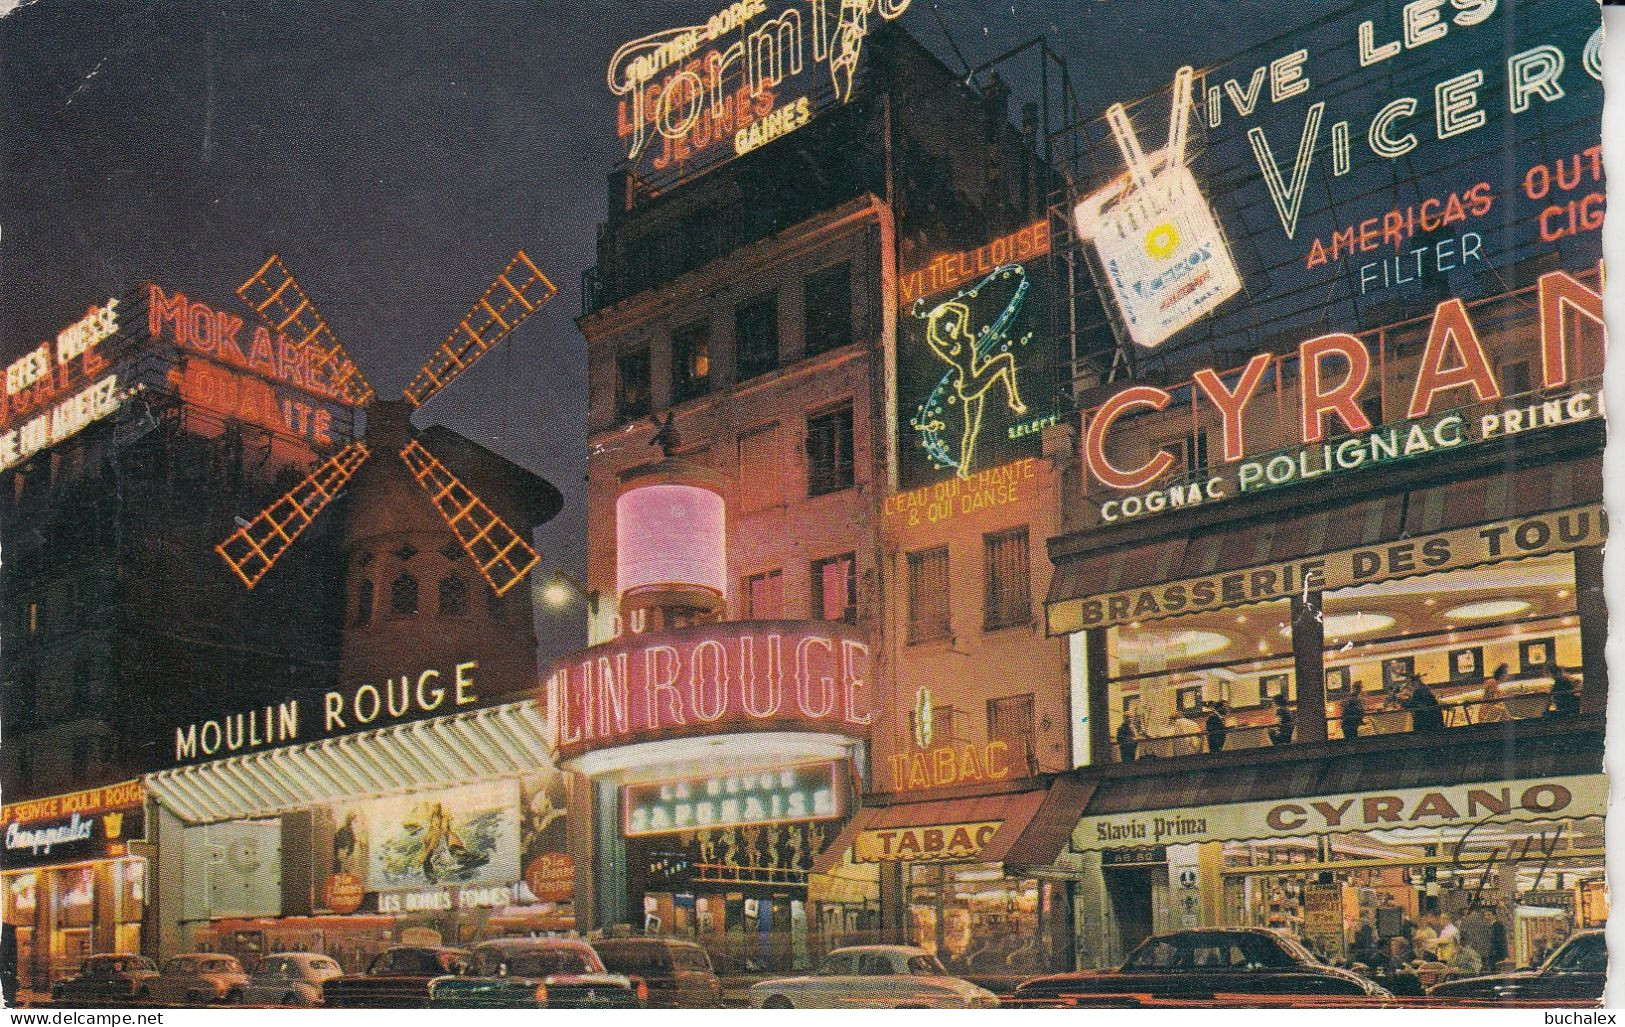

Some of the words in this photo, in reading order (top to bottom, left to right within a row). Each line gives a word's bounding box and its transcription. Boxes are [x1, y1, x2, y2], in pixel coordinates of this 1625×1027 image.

[735, 96, 811, 157] GAINES
[1305, 182, 1494, 270] AMERICA'S
[1360, 232, 1484, 294] FILTER
[968, 457, 1035, 494] CHANTE
[1101, 476, 1226, 523] COGNAC
[1239, 414, 1463, 493] POLIGNAC
[929, 499, 954, 524] QUI
[963, 482, 1020, 514] DANSE
[1081, 558, 1324, 625] BRASSERIE
[1352, 537, 1452, 580] DES
[175, 699, 298, 761] MOULIN
[324, 661, 479, 732] ROUGE
[646, 634, 873, 731] ROUGE
[888, 740, 1010, 792] TABAC
[1096, 818, 1147, 842] Slavia
[1152, 814, 1208, 843] Prima
[1266, 783, 1573, 832] CYRANO
[876, 825, 997, 855] TABAC
